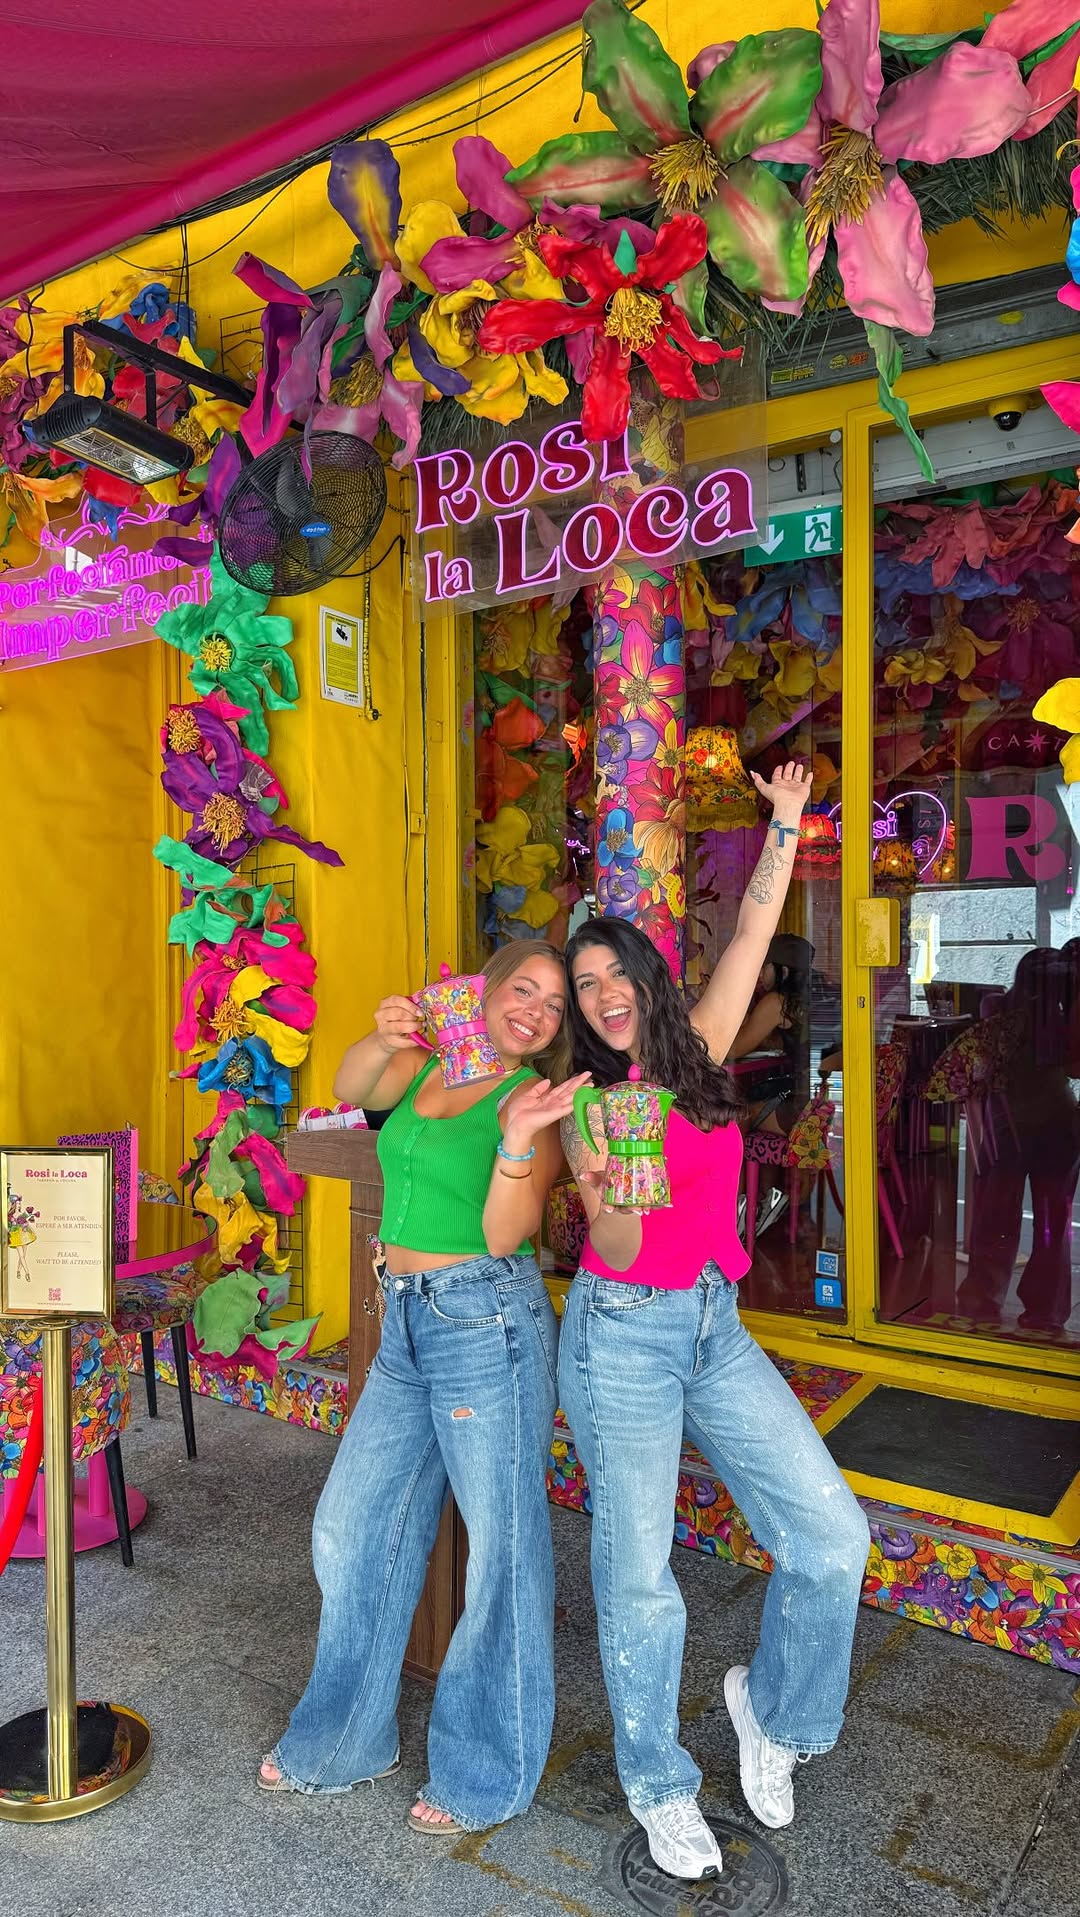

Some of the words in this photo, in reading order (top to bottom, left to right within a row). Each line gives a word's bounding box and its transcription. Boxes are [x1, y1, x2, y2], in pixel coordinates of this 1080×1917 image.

[425, 551, 474, 602] la
[495, 468, 758, 595] Loca
[25, 1168, 50, 1178] Rosi
[60, 1170, 88, 1178] Loca
